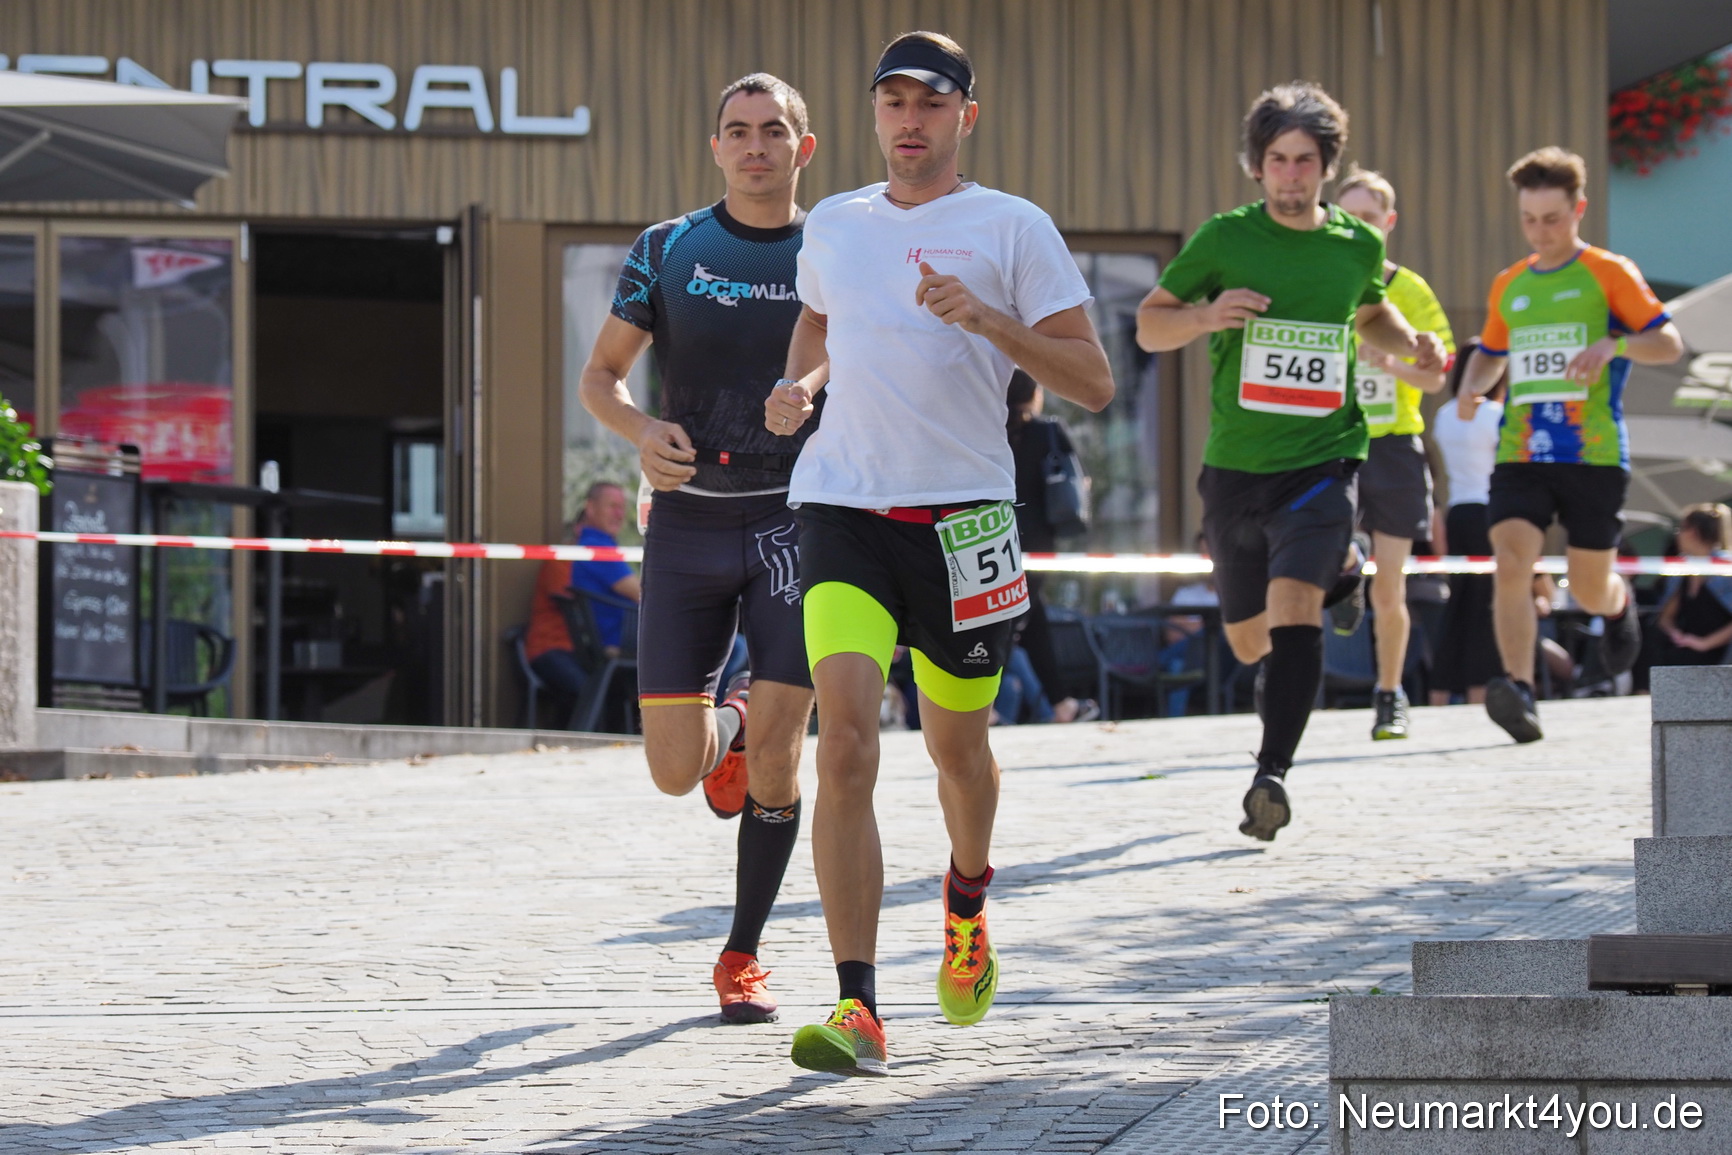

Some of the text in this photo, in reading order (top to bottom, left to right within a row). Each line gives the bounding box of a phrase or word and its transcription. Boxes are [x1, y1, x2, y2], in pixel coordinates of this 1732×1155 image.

[923, 248, 955, 256] HUMAN
[955, 248, 974, 258] ONE
[1254, 325, 1336, 347] BOCK
[1265, 353, 1326, 384] 548
[1522, 352, 1567, 377] 189
